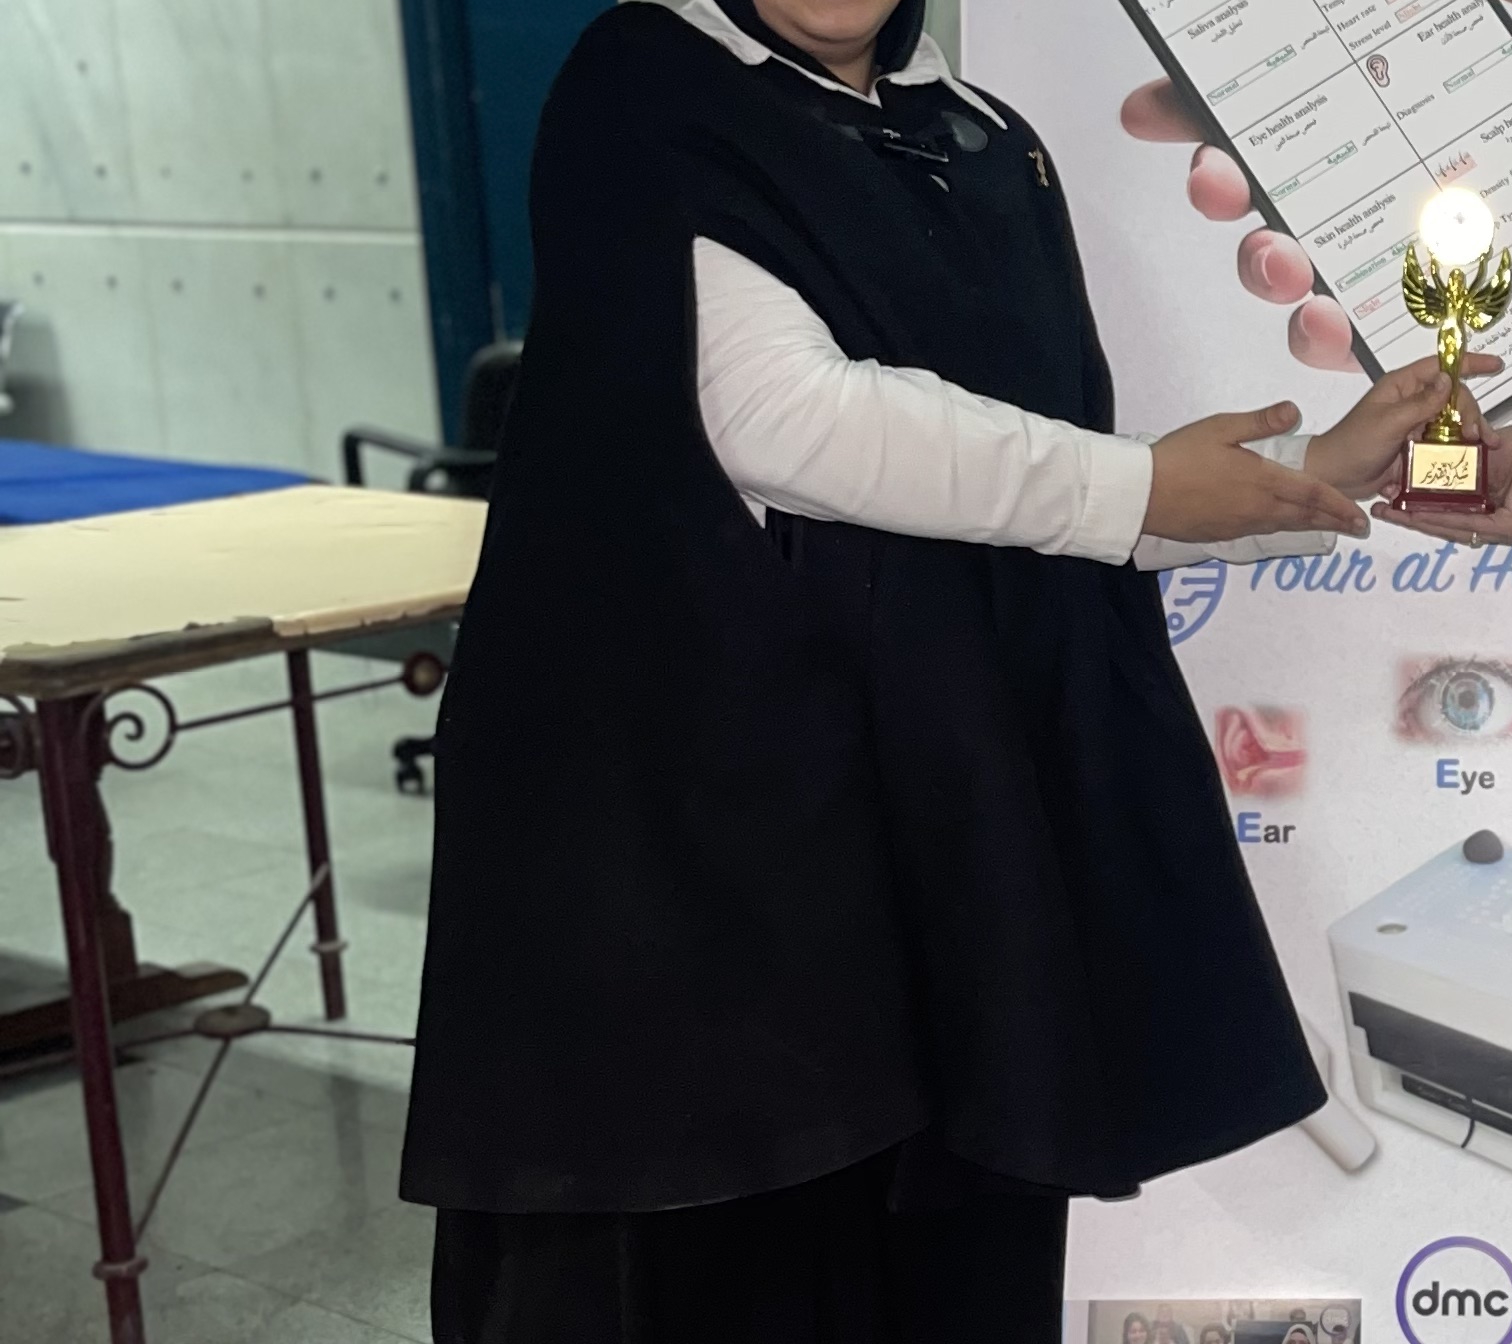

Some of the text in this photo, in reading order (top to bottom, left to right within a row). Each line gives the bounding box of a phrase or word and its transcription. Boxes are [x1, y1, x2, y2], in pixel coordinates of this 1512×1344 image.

[1186, 0, 1249, 40] Saliva analysis
[1336, 5, 1378, 33] Heart rate
[1348, 19, 1393, 51] Stress level
[1416, 27, 1435, 43] Ear
[1432, 10, 1462, 33] health
[1248, 94, 1328, 147] Eye health analysis
[1395, 93, 1436, 121] Diagnosis
[1479, 124, 1506, 144] Scalp
[1313, 194, 1397, 249] Skin health analysis
[1392, 541, 1458, 593] at
[1436, 758, 1496, 796] Eye
[1237, 811, 1297, 844] Ear
[1412, 1281, 1510, 1317] dmc
